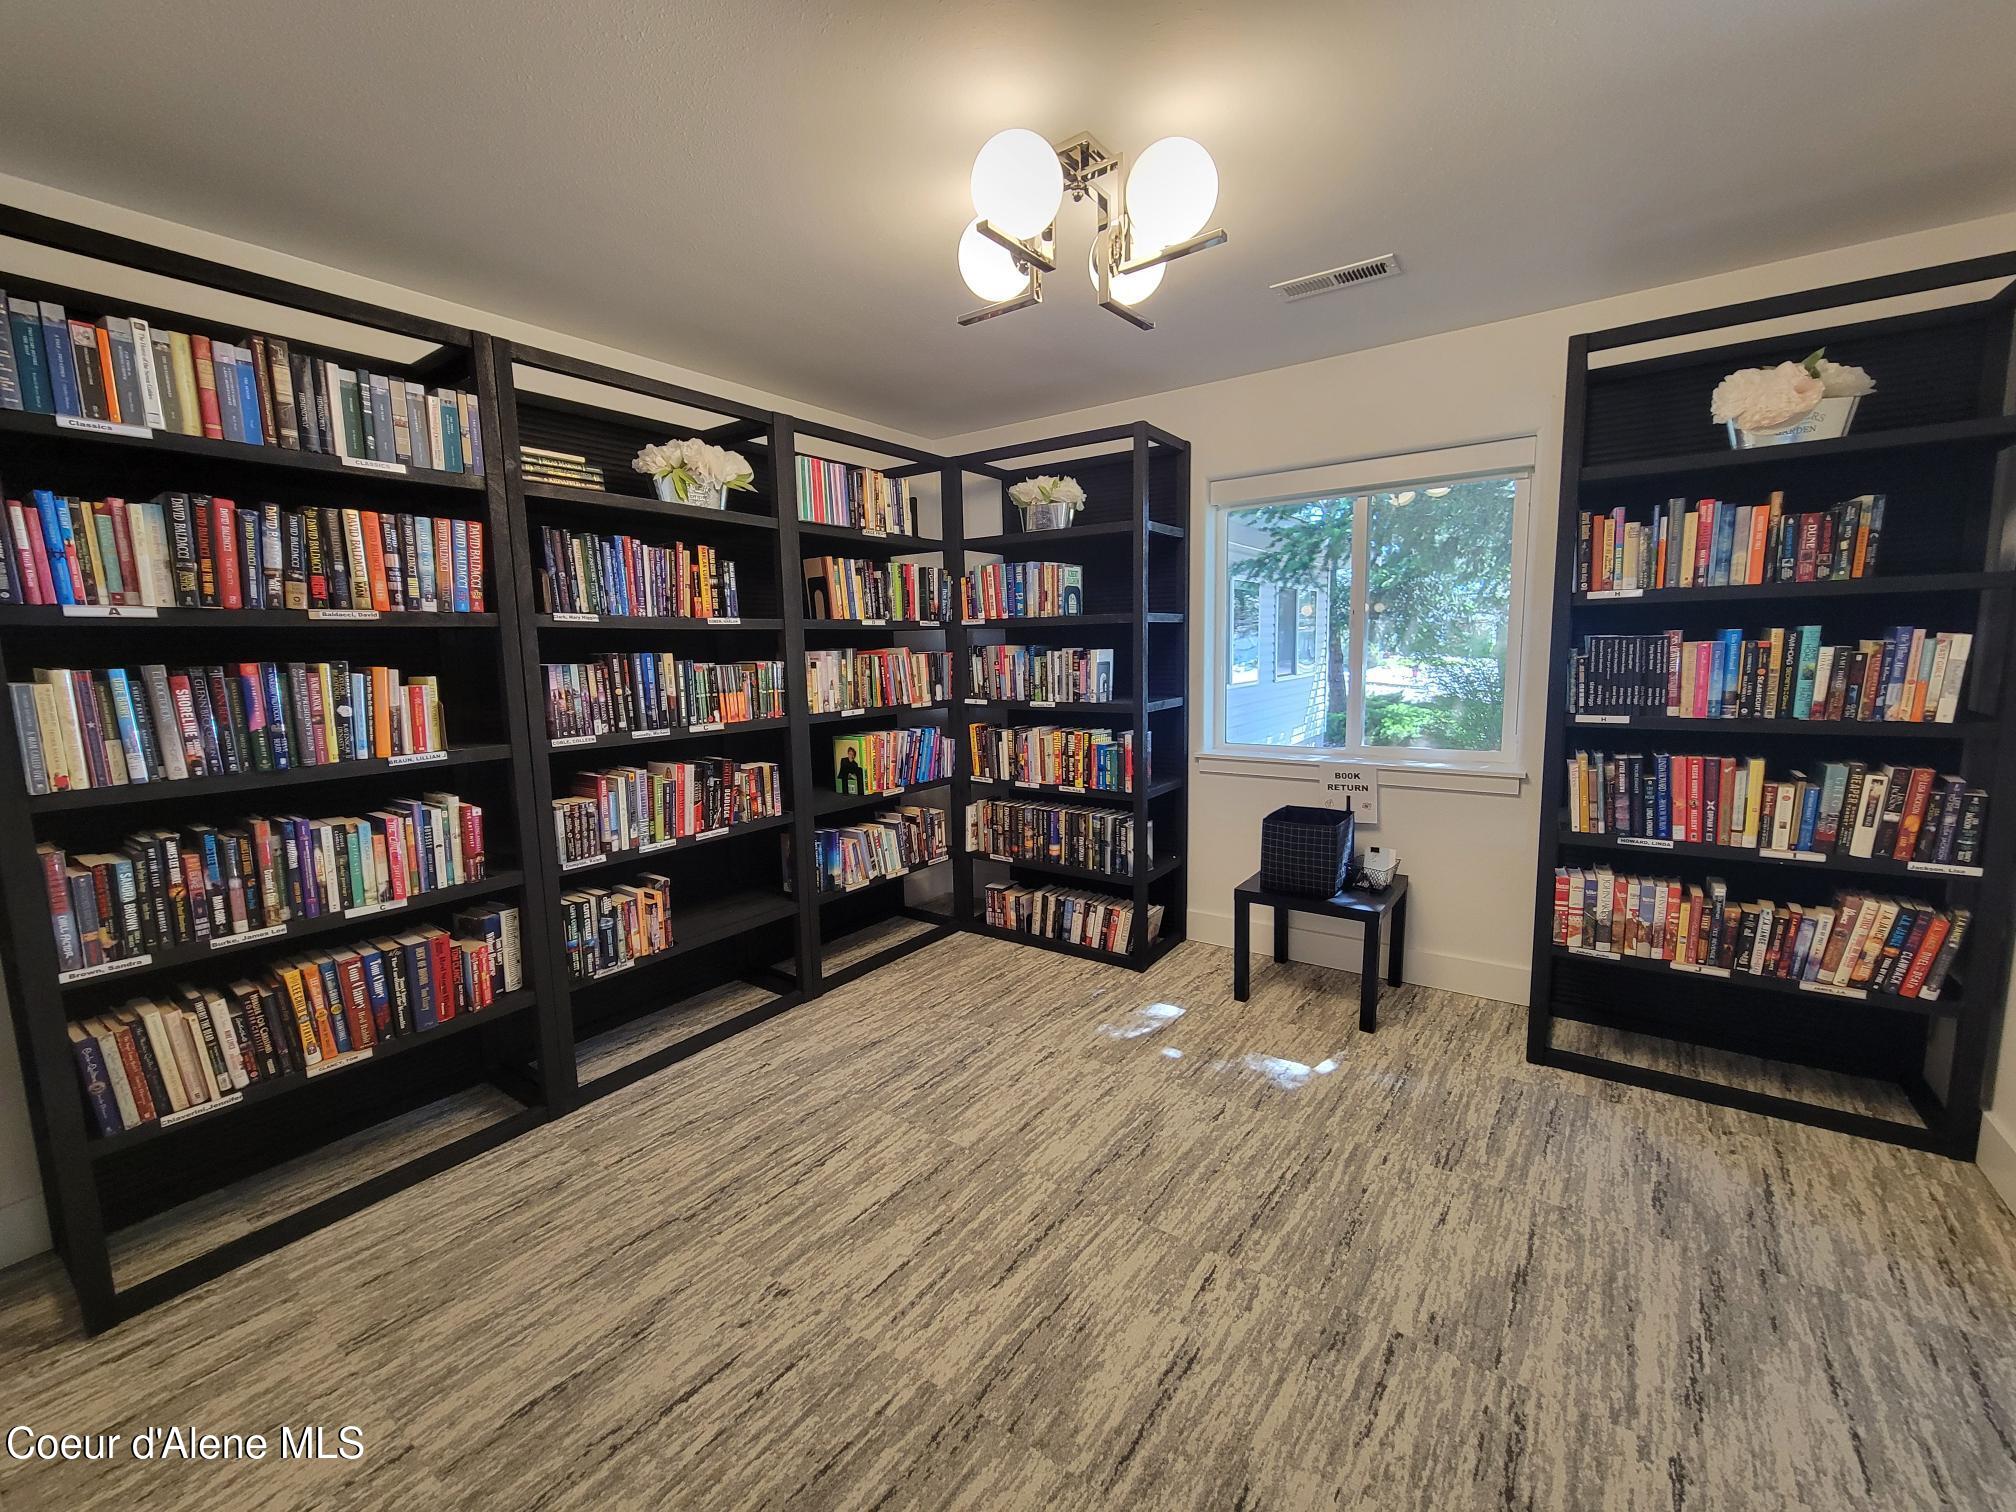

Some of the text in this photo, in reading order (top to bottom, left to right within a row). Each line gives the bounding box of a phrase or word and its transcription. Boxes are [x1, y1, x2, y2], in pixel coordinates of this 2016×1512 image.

[68, 419, 113, 432] Classics
[355, 460, 391, 470] CLASSICS
[171, 497, 190, 559] DAVID BALDACCI
[219, 507, 232, 552] DAVID BALDACCI
[244, 522, 256, 566] DAVID BALDACCI
[290, 515, 300, 568] DAVID BALDACCI
[384, 523, 392, 552] BALDACCI
[1805, 524, 1817, 550] DUNE
[306, 518, 328, 601] DAVID BALDACCI MERCY
[346, 512, 365, 599] DAVID BALDACCI MAN
[404, 524, 417, 577] DAVID BALDACCI
[455, 523, 468, 589] DAVID BALDACCI
[468, 524, 482, 589] DAVID BALDACCI
[1839, 525, 1852, 568] INTO WATER
[701, 546, 710, 588] HARLAN COBEN
[108, 607, 122, 616] A
[357, 611, 378, 620] David
[1895, 632, 1909, 659] The White
[1836, 651, 1847, 688] TAMI HOAG
[112, 677, 130, 720] DAVE BARRY
[195, 679, 213, 730] GLENN BECK
[1754, 675, 1765, 711] SEABISCUIT
[175, 689, 199, 738] SHORELINE
[298, 668, 316, 752] ALL THE PRESIDENT'S MEN
[1327, 783, 1369, 792] RETURN
[1334, 772, 1361, 780] BOOK
[1657, 758, 1667, 792] LINDA HOWARD
[723, 788, 731, 819] DEADLOCK
[1764, 792, 1774, 815] John Irving
[1827, 777, 1846, 835] GREG ILES
[1888, 785, 1900, 812] JACKSON
[1911, 781, 1929, 814] LISA JACKSON
[1706, 810, 1714, 827] ORPHAN
[423, 825, 433, 849] ODYSSEY
[468, 832, 476, 848] THIEF
[1620, 838, 1650, 846] HOWARD,
[166, 840, 182, 885] JAMES LEE BURKE
[1910, 865, 1944, 873] Jackson,
[120, 872, 140, 931] SANDRA BROWN
[571, 919, 579, 940] CUSSLER
[1757, 916, 1771, 945] J.A. JANCE
[1873, 910, 1894, 940] J.A. JANCE
[1900, 914, 1912, 926] J.A.
[1949, 917, 1967, 942] J.A. JANCE
[211, 927, 287, 948] Burke, James Lee
[1889, 927, 1908, 948] JANCE
[1890, 915, 1929, 985] J.A. JANCE CLAWBACK
[68, 959, 143, 980] Brown, Sandra
[451, 947, 461, 984] TOM CLANCY
[485, 932, 497, 977] Without Remorse
[1882, 957, 1893, 969] TRIAL
[369, 958, 385, 999] Tom Clancy
[415, 946, 431, 1012] DEBT OF HONOR Tom Clancy
[1875, 974, 1885, 984] FIRE
[290, 983, 307, 1015] LEE CHILD
[325, 971, 346, 1042] LEE CHILD SENTINEL
[348, 961, 370, 1044] Tom Clancy Red Rabbit
[249, 993, 273, 1054] MURDER FOR CHRISTMAS
[318, 1055, 359, 1072] CLANCY, TOM
